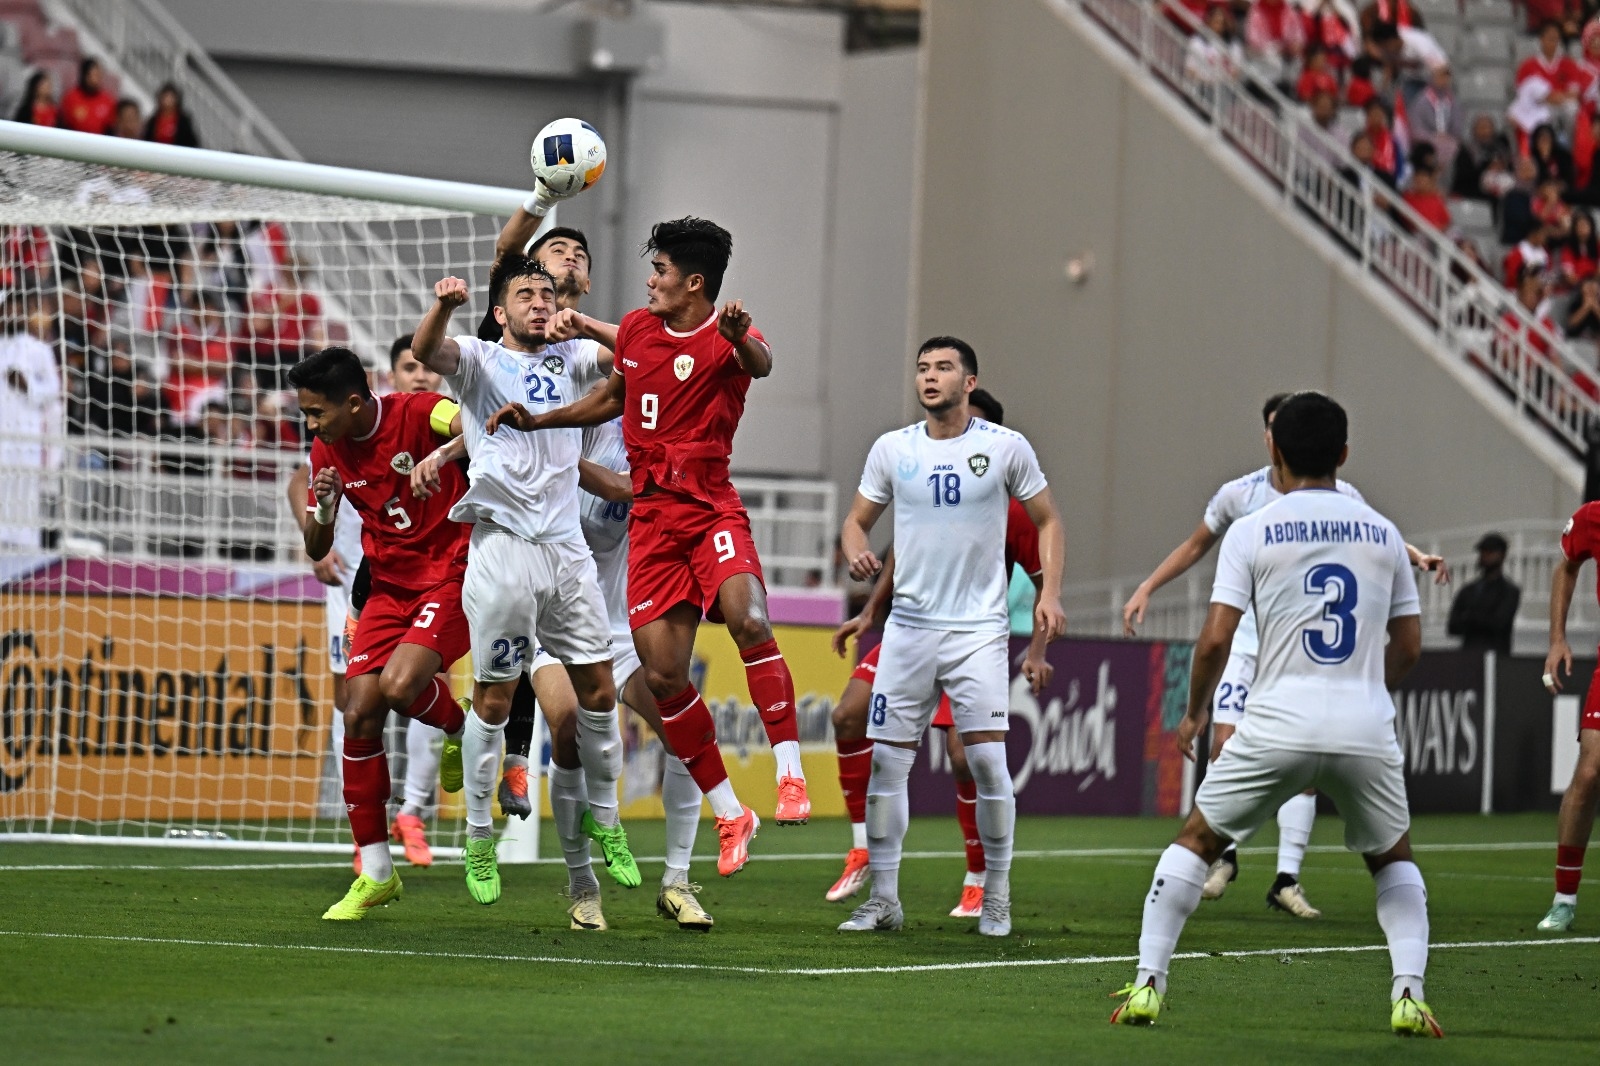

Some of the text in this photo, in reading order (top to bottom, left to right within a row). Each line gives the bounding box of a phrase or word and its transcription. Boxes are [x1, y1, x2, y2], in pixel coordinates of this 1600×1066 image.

[544, 357, 562, 370] UFA
[524, 373, 562, 405] 22
[641, 393, 659, 430] 9
[970, 457, 988, 468] UFA
[345, 480, 367, 489] erspo
[927, 473, 961, 507] 18
[383, 496, 412, 530] 5
[713, 530, 735, 563] 9
[1264, 520, 1388, 547] ABDIRAKHMATOV
[413, 602, 441, 629] 5
[630, 599, 653, 615] erspo
[1302, 562, 1359, 665] 3
[490, 635, 530, 670] 22
[1217, 682, 1249, 713] 23
